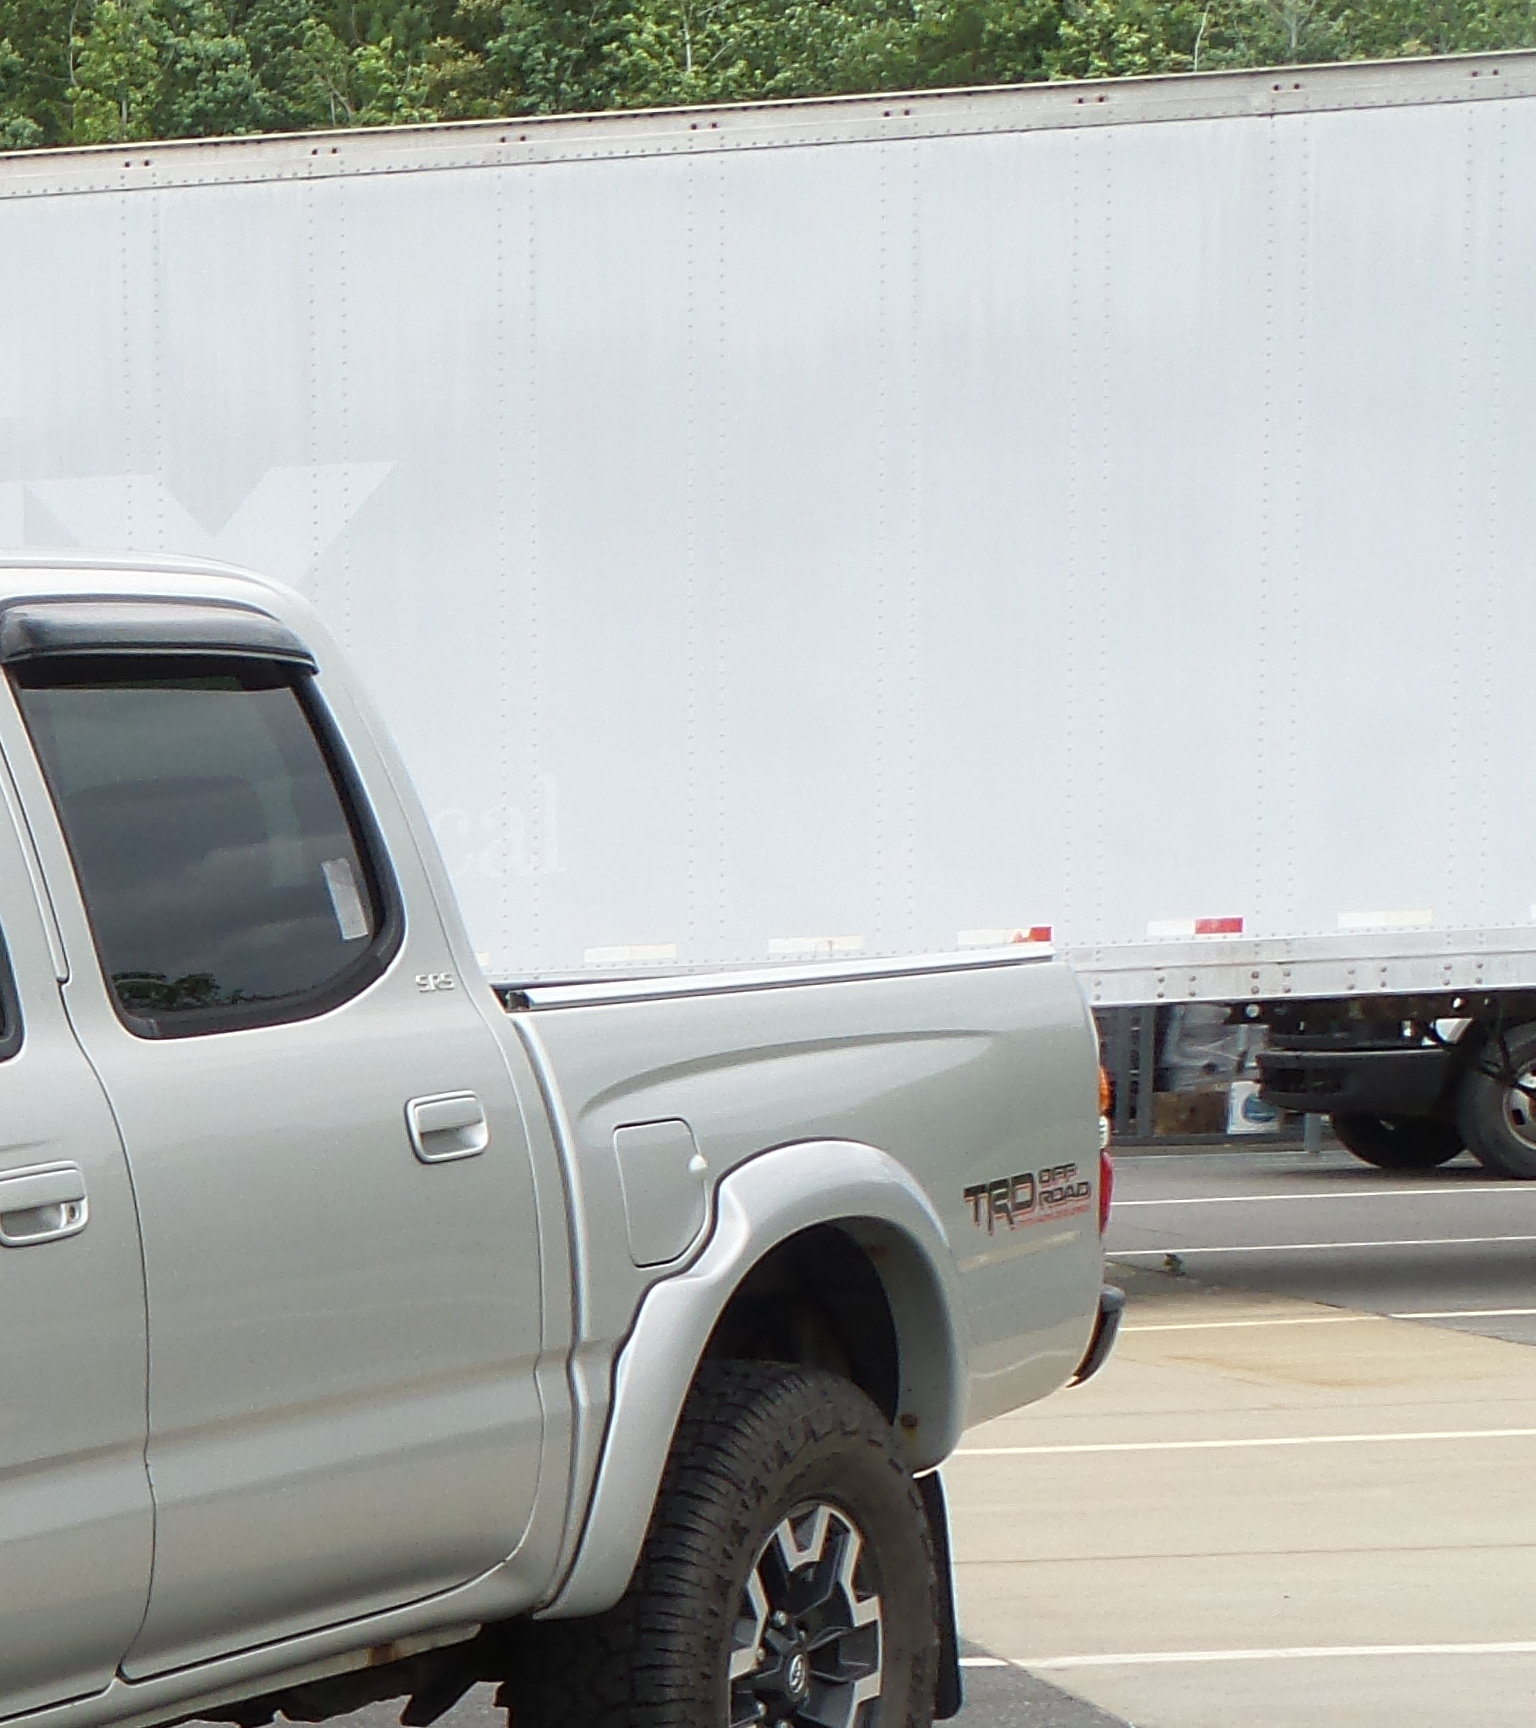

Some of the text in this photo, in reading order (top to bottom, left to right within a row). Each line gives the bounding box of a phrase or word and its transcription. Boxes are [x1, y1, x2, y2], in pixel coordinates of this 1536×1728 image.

[1038, 1161, 1077, 1185] OFF
[963, 1172, 1035, 1236] TRD
[1038, 1180, 1092, 1209] ROAD
